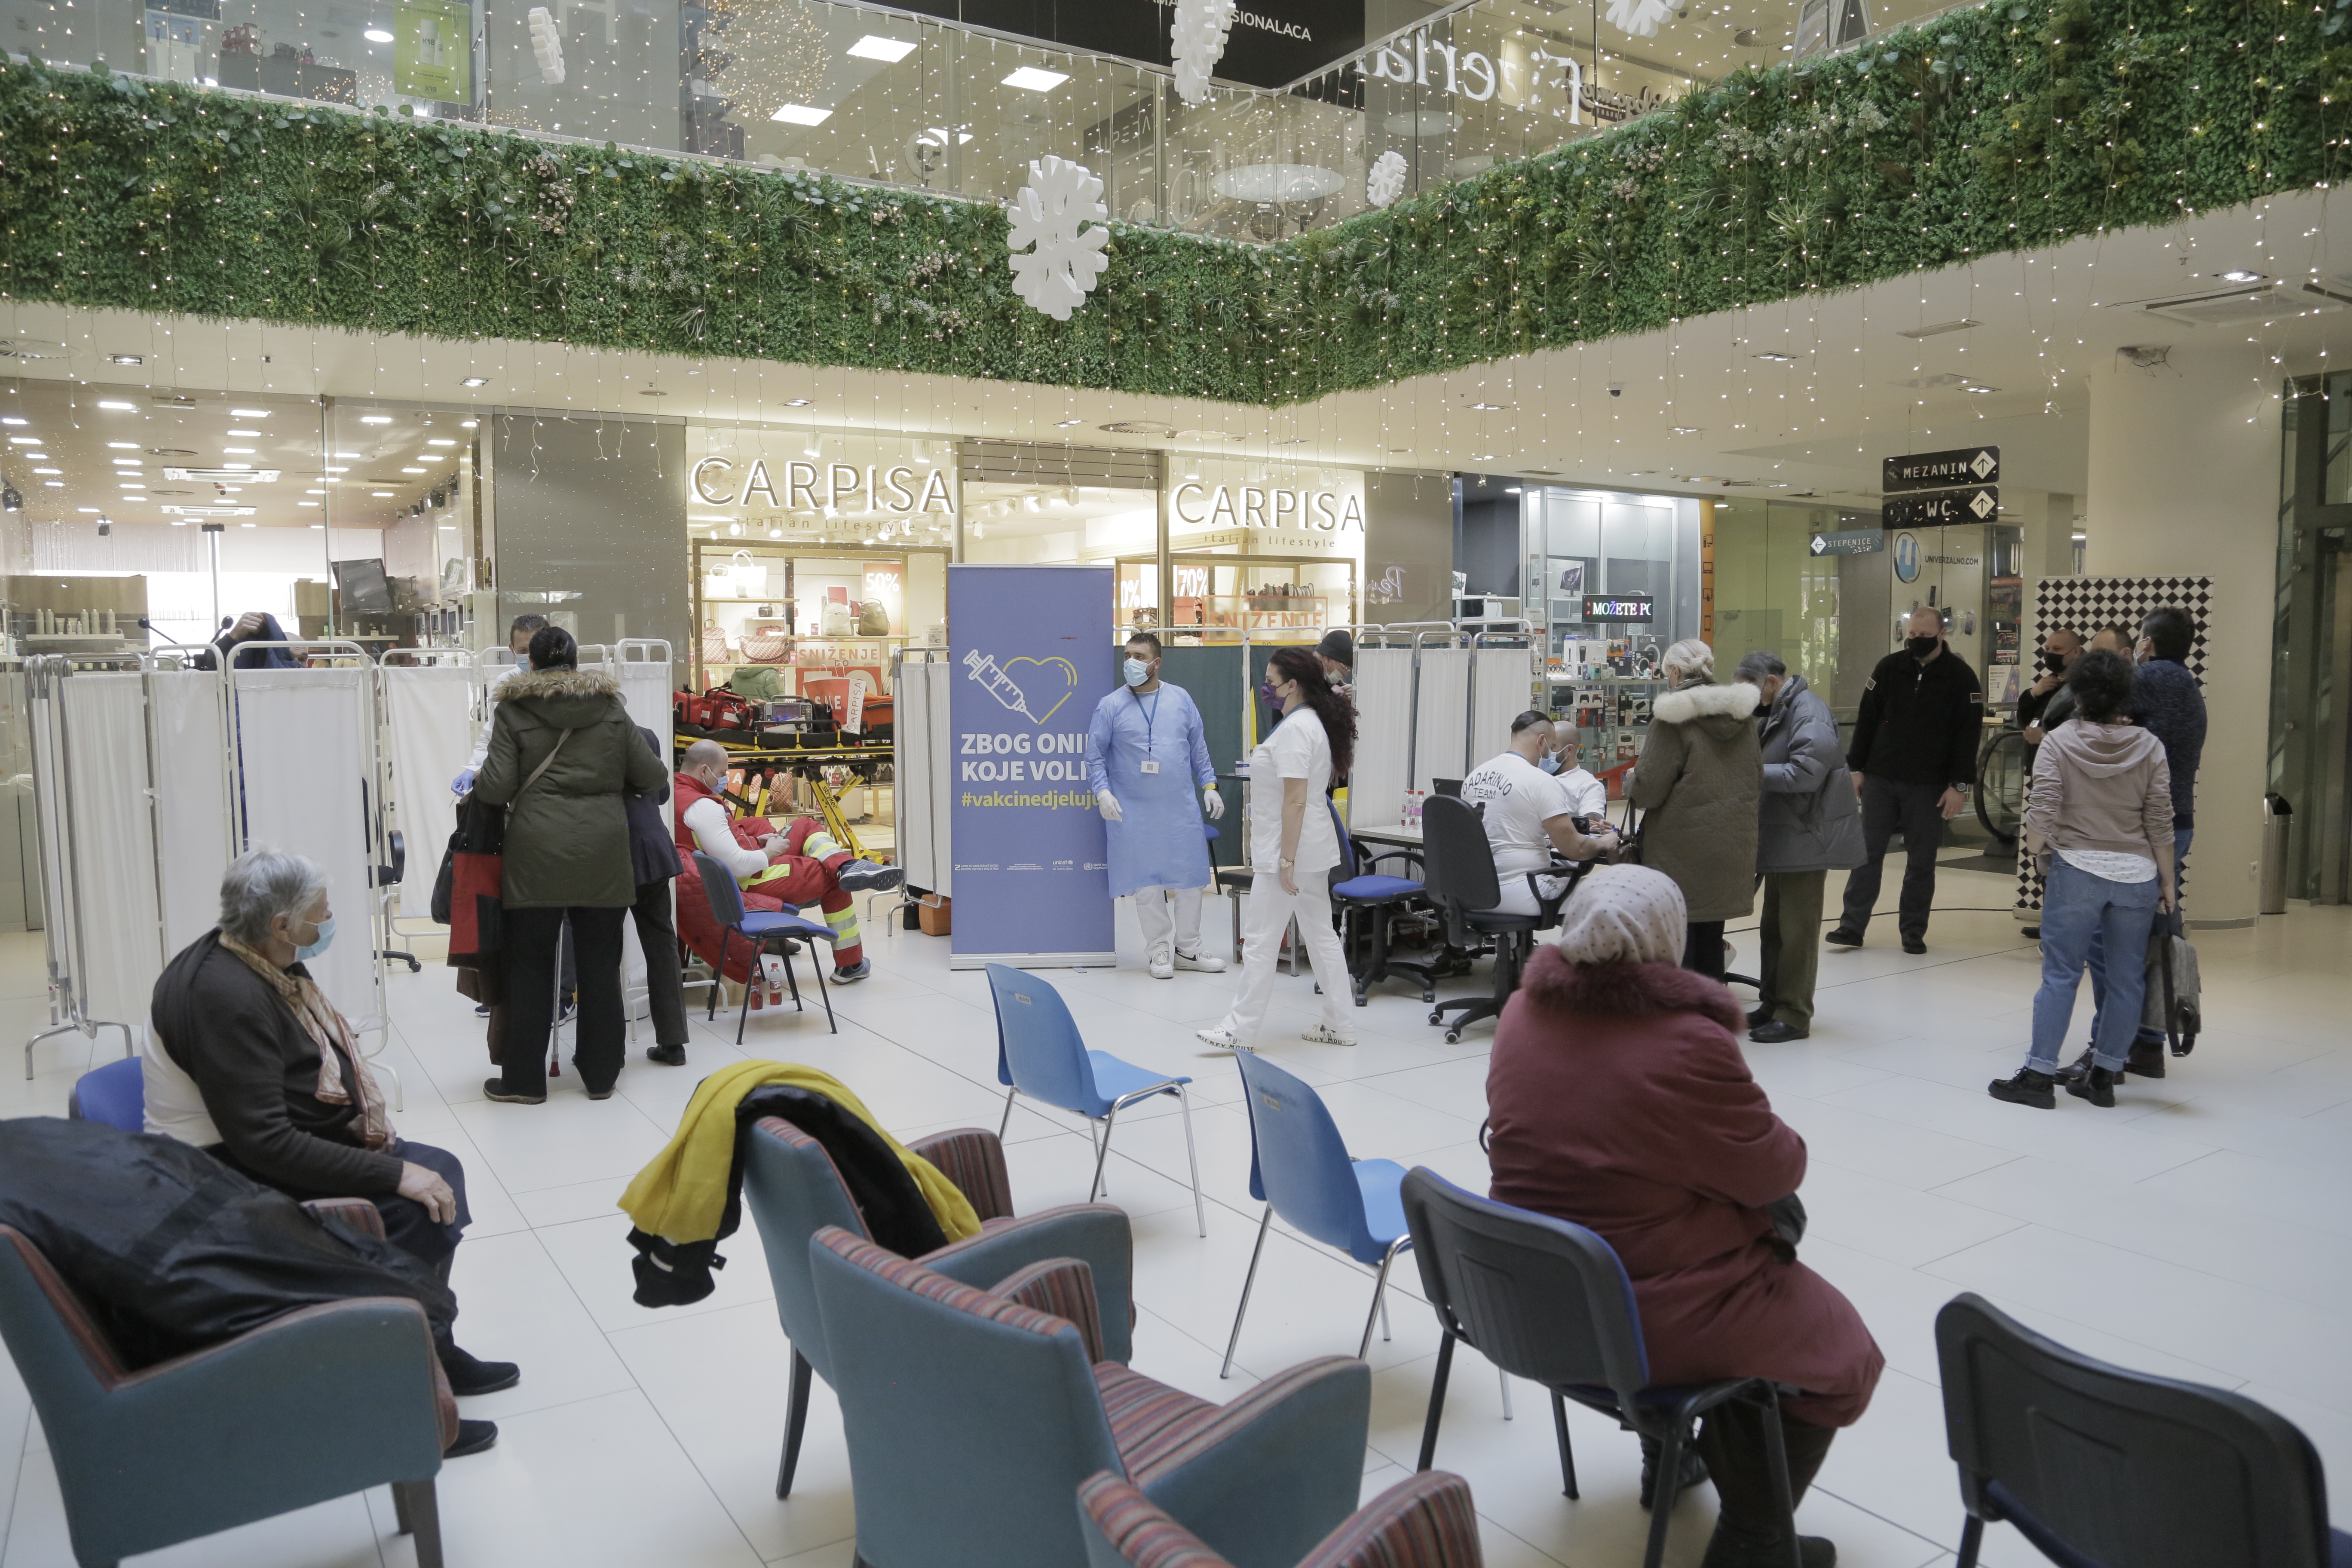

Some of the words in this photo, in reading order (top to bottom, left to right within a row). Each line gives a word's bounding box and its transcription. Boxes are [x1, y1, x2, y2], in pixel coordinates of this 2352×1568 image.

[1231, 9, 1312, 42] SIONALACA
[1903, 462, 1967, 479] MEZANIN
[692, 456, 955, 514] CARPISA
[1172, 483, 1365, 532] CARPISA
[1926, 499, 1951, 517] WC
[737, 517, 810, 529] italian
[825, 518, 916, 533] lifestyle
[1204, 533, 1259, 544] italian
[1269, 536, 1335, 549] lifestyle
[1828, 537, 1871, 547] STEPENICE
[1925, 555, 1978, 565] UNIVERZALNO.COM
[866, 573, 900, 592] 50%
[1178, 567, 1207, 597] 70%
[1120, 579, 1141, 609] 0%
[1592, 601, 1638, 615] MOŽETE
[799, 646, 878, 660] SNIŽENJE
[847, 682, 863, 731] CARPISA
[961, 733, 1031, 754] ZBOG
[962, 761, 1025, 781] KOJE
[1029, 760, 1087, 781] VOLI
[1473, 788, 1497, 799] TEAM
